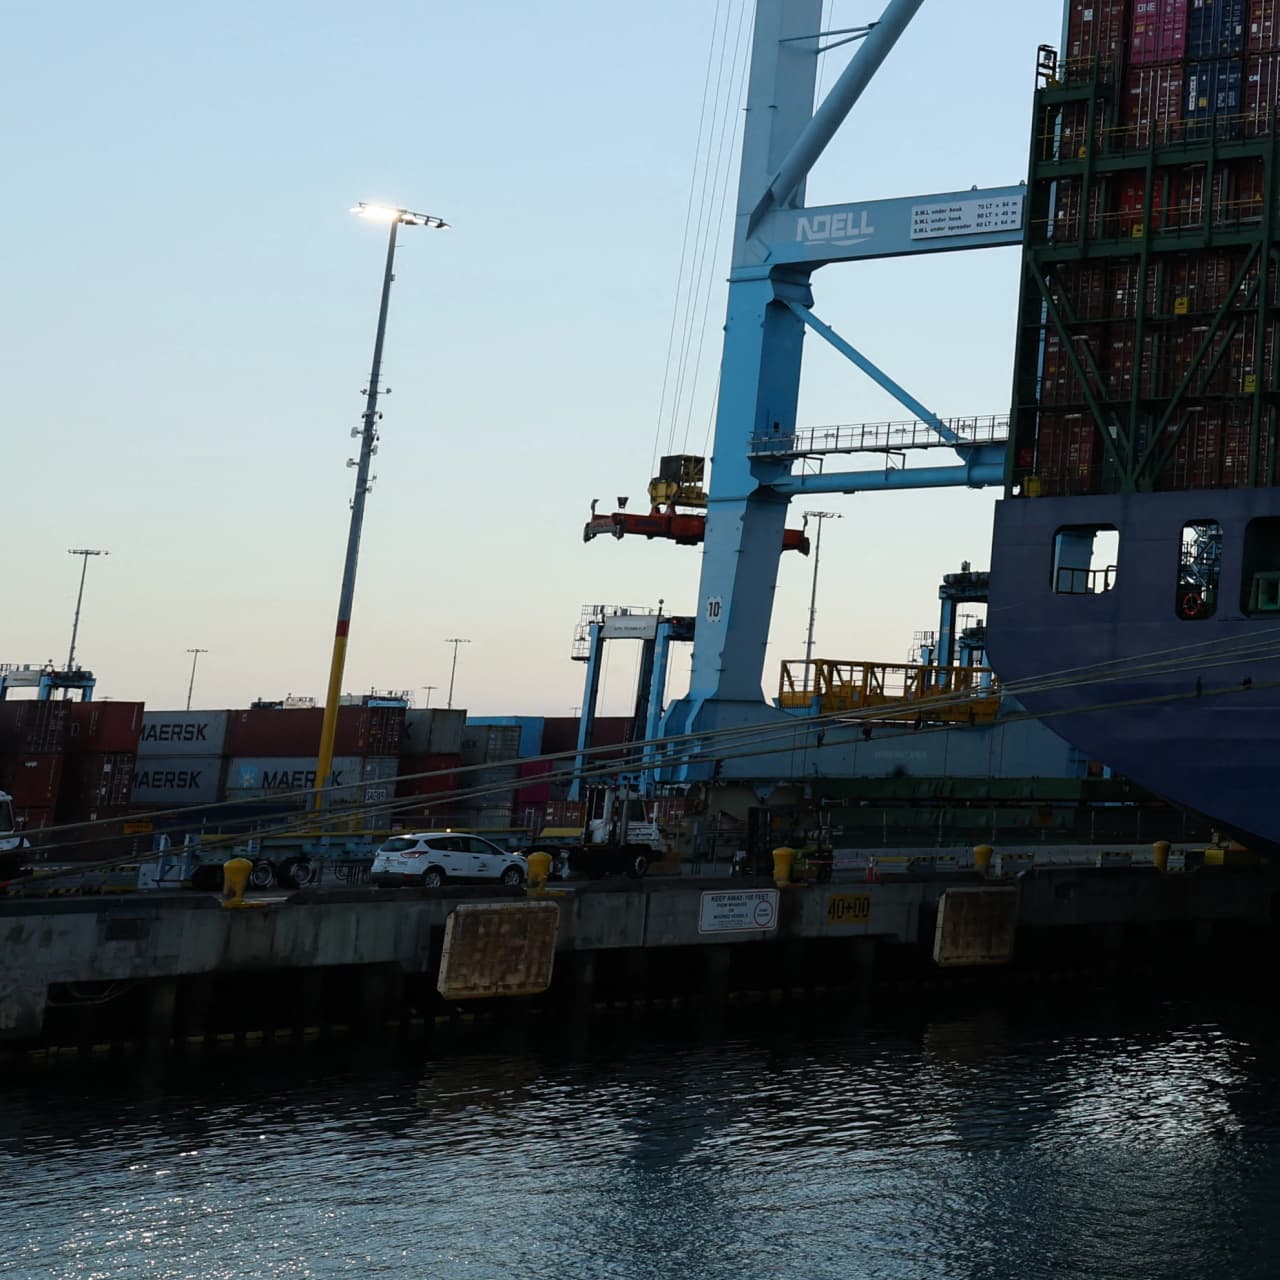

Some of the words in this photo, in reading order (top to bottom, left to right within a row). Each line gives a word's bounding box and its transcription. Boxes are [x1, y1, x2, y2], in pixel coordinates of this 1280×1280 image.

[1137, 3, 1156, 13] ONE
[796, 209, 874, 241] NOELL
[709, 601, 720, 617] 10
[262, 770, 343, 789] MAERK
[828, 897, 870, 920] 40+00
